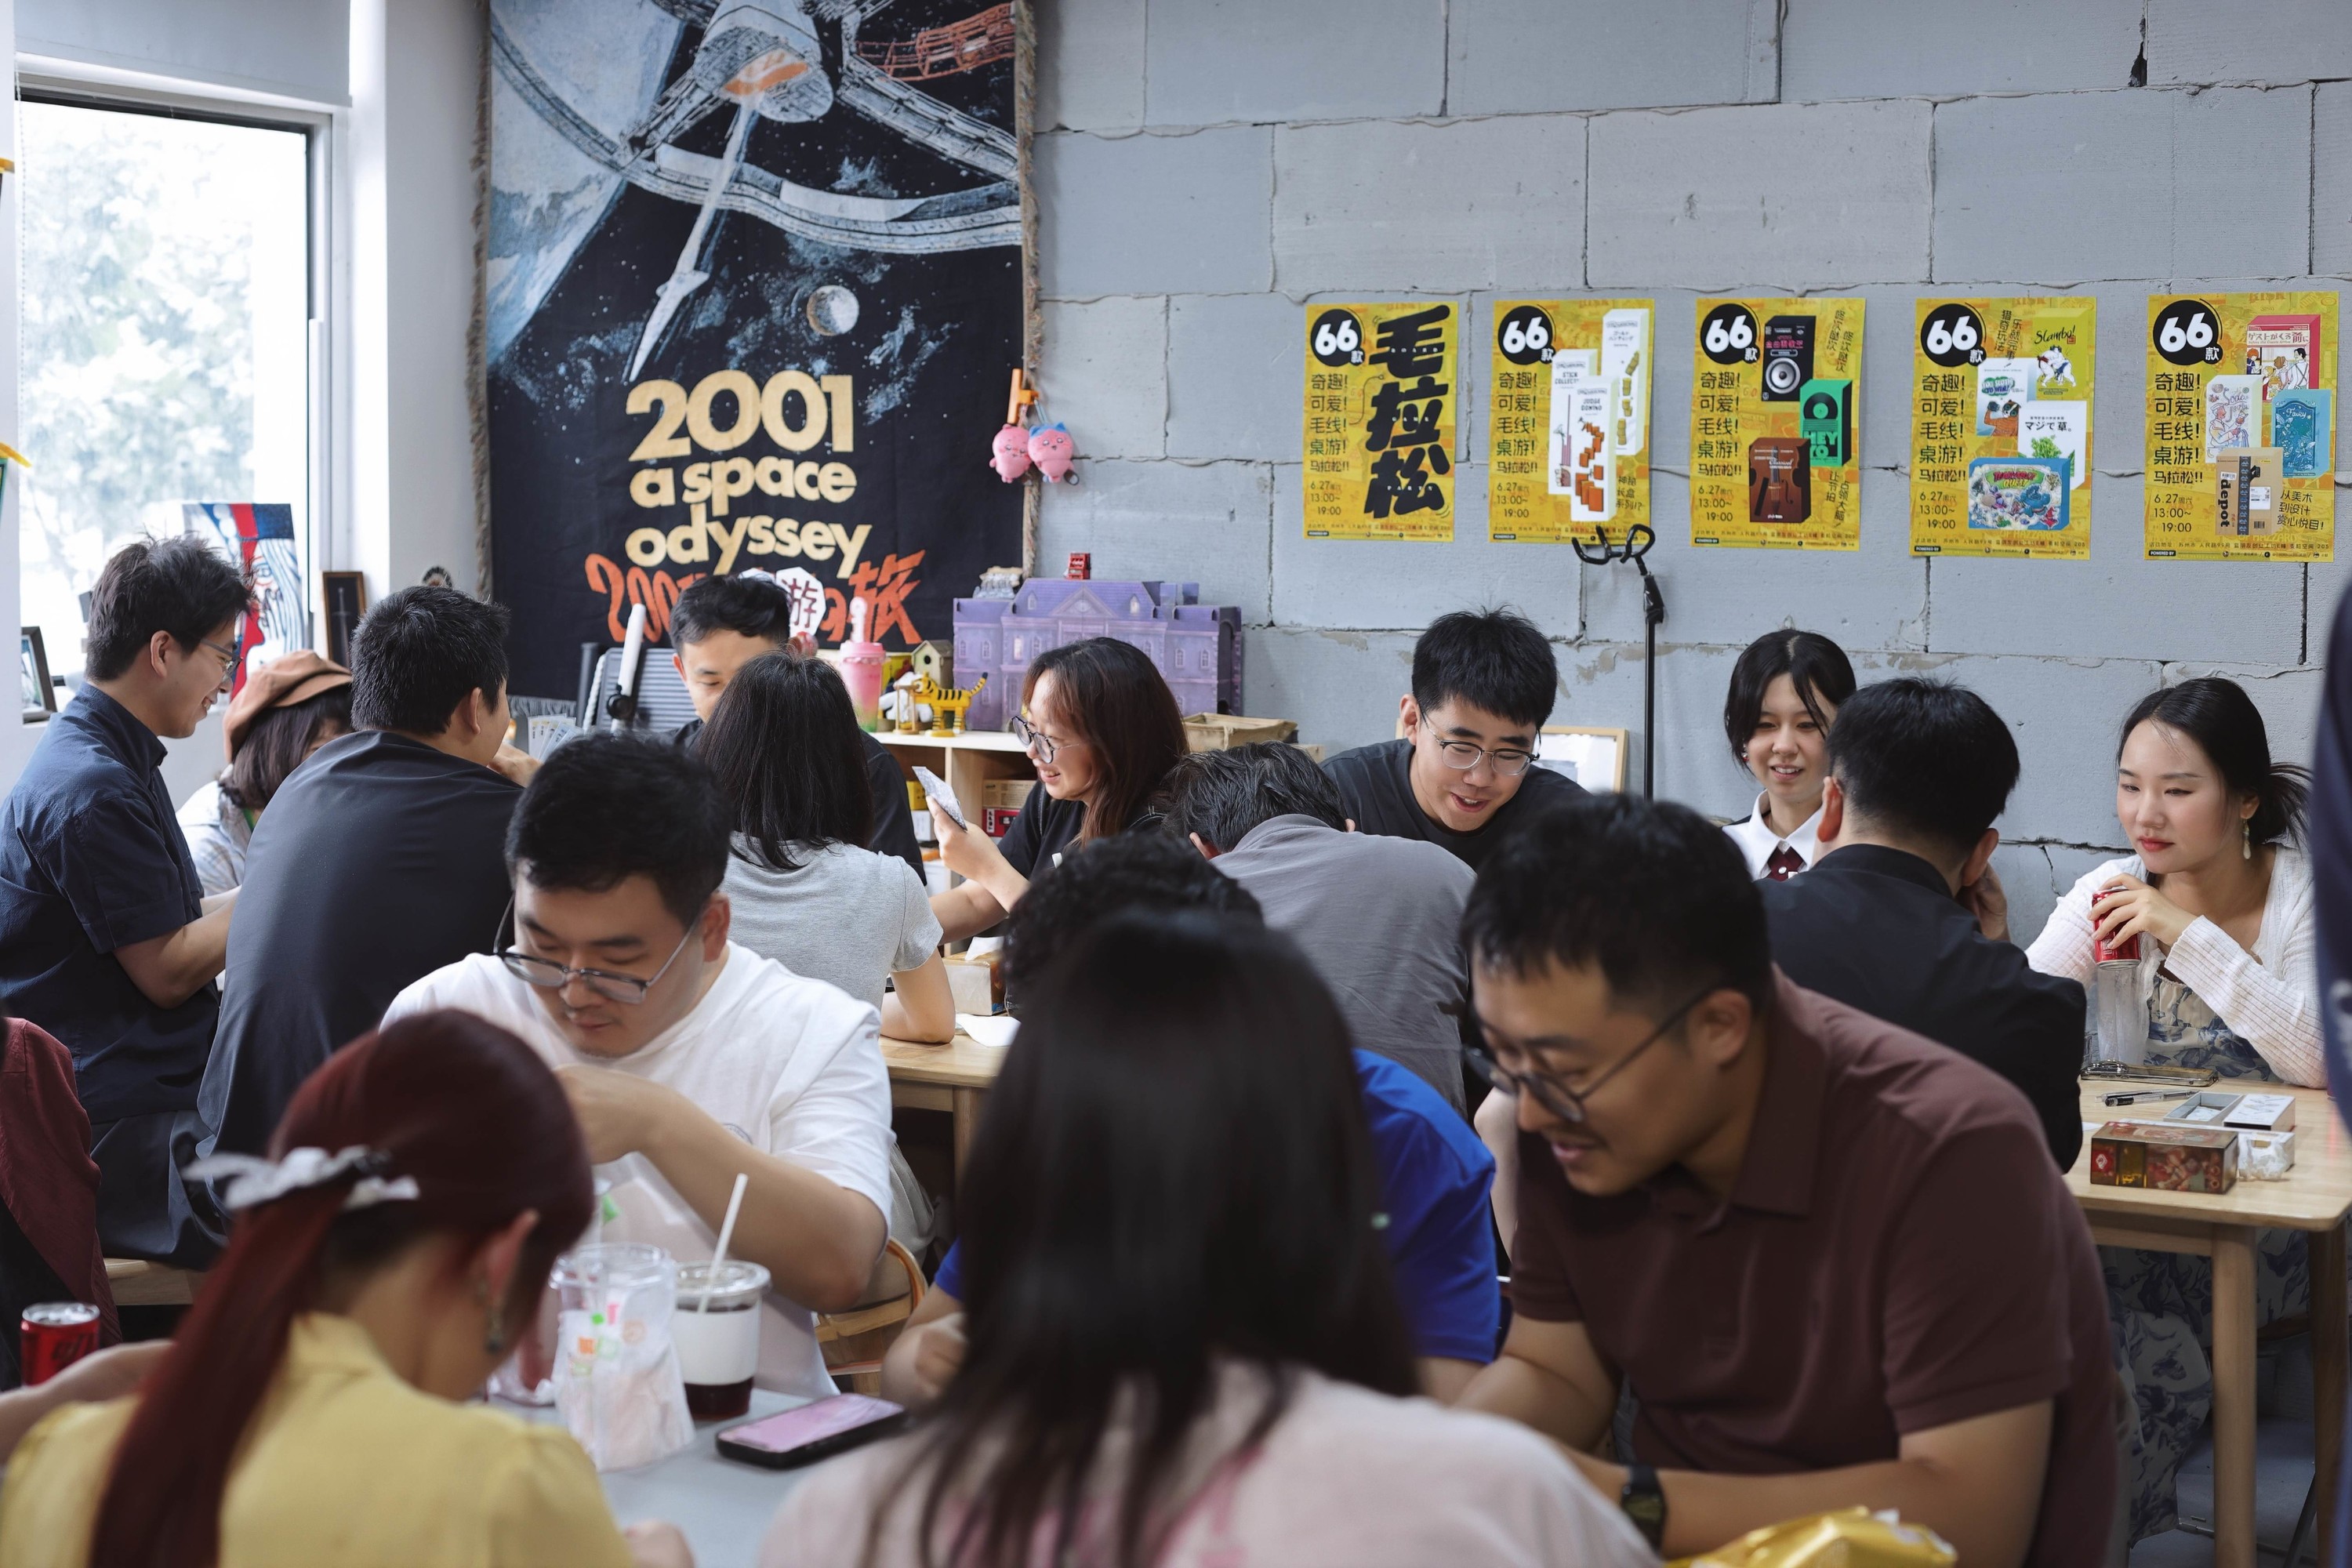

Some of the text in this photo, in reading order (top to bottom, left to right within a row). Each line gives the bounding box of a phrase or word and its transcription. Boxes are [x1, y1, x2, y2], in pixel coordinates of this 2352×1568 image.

[2154, 372, 2201, 391] 奇趣!
[626, 369, 855, 462] 2001
[1364, 305, 1450, 519] 毛拉松
[2155, 397, 2200, 416] 可爱!
[2154, 422, 2199, 441] 毛线!
[2154, 446, 2199, 466] 桌游!
[630, 456, 858, 517] a space
[2281, 490, 2313, 503] 从美术
[2218, 479, 2231, 528] depot
[2279, 502, 2310, 516] 到设计
[625, 503, 873, 579] odyssey
